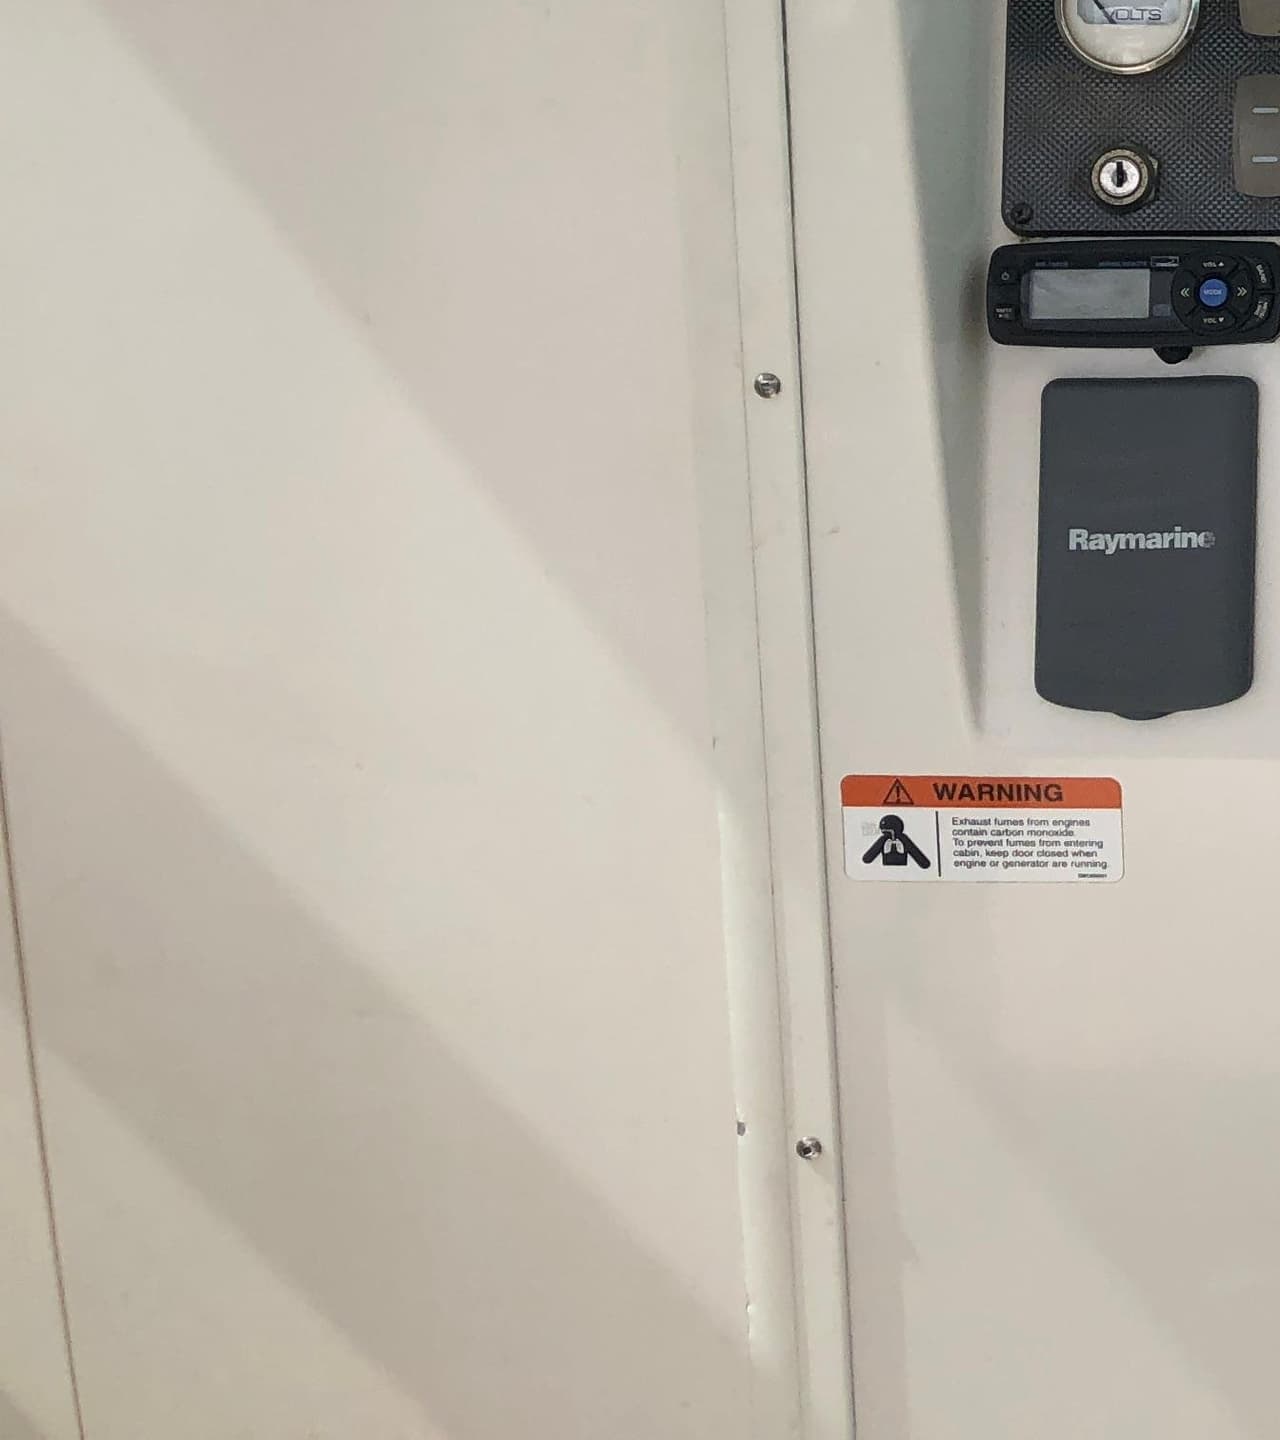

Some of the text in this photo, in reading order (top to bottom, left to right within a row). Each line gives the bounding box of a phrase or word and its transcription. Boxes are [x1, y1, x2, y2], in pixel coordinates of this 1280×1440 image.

[1109, 9, 1161, 21] VOLTS
[1068, 526, 1216, 555] Raymarine
[933, 783, 1063, 802] WARNING
[952, 817, 1090, 828] Exhaust fumes from engines
[952, 828, 987, 837] contain
[990, 828, 1024, 837] carbon
[953, 838, 1103, 849] To prevent fumes from entering
[953, 848, 1097, 859] cabin, keep door closed when
[954, 859, 986, 869] engine
[990, 860, 999, 868] or
[1002, 860, 1049, 869] generator
[1052, 860, 1067, 868] are
